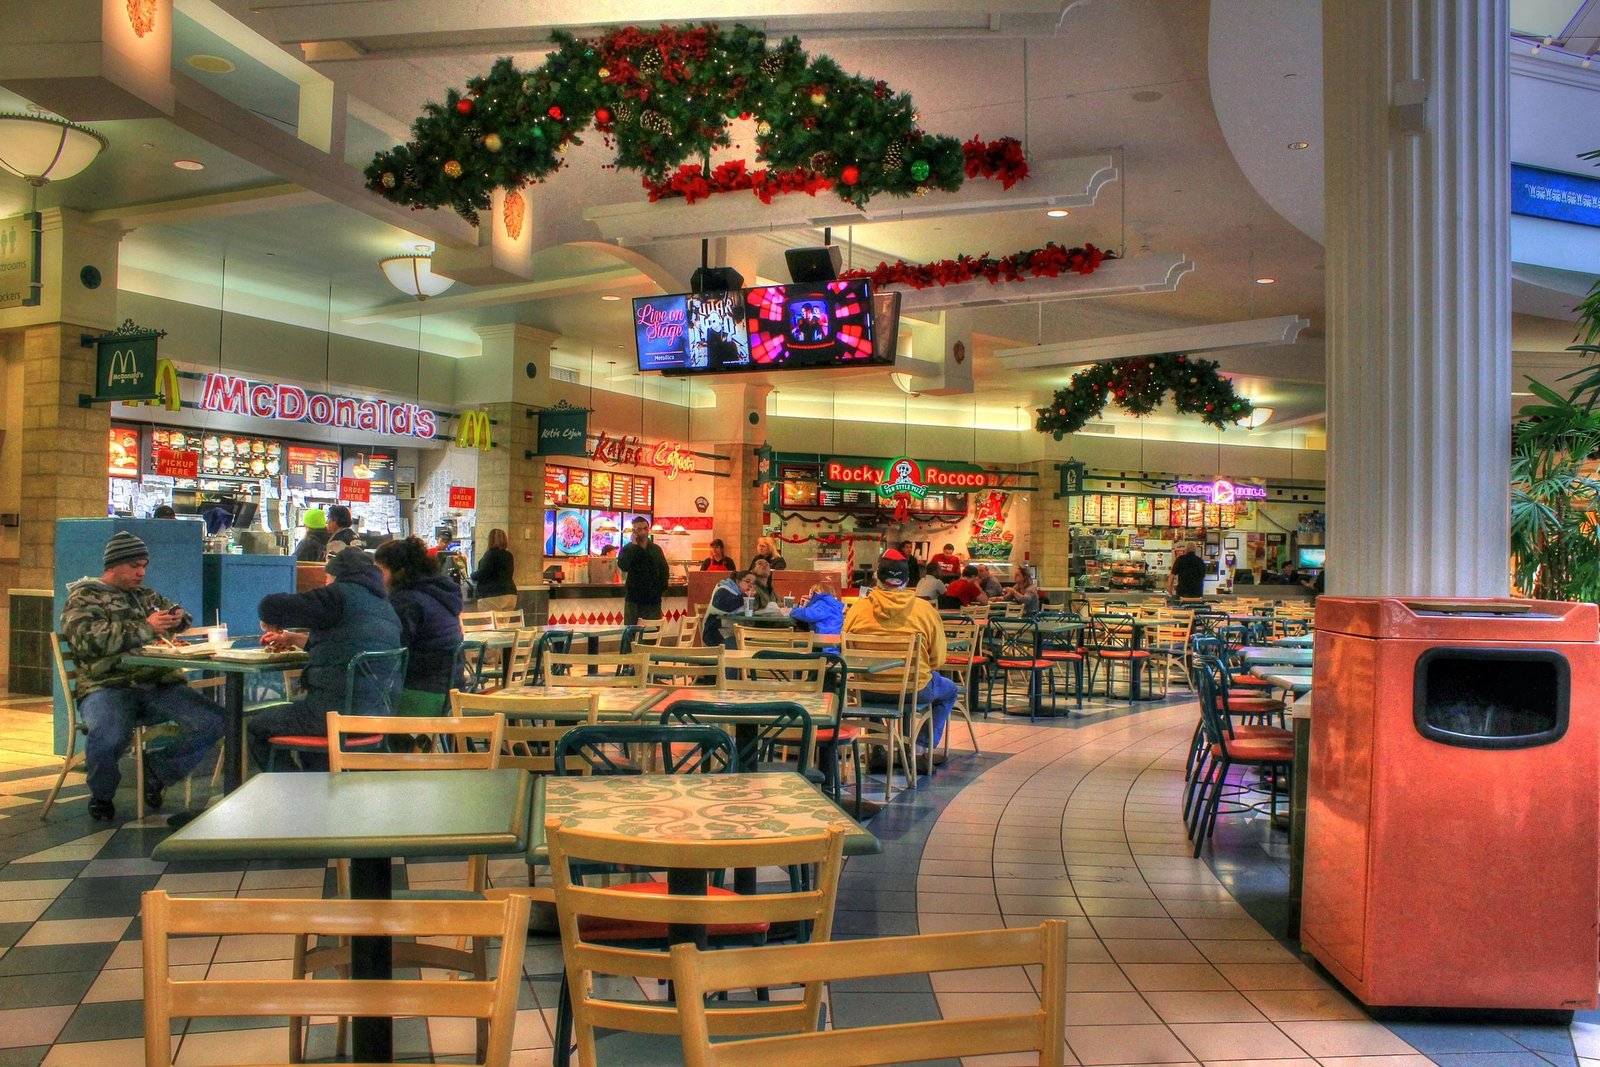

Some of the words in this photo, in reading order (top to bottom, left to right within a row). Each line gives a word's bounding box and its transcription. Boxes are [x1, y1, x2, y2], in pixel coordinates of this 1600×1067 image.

[637, 304, 669, 326] Live
[669, 309, 685, 322] on
[646, 322, 684, 346] Stage
[112, 371, 144, 380] McDonald's
[200, 373, 437, 439] McDonald's
[161, 458, 194, 469] PICKUP
[653, 441, 695, 481] Cajun
[165, 467, 189, 476] HERE
[829, 463, 885, 486] Rocky
[926, 468, 985, 486] Rococo
[343, 486, 366, 494] ORDER
[1177, 484, 1212, 494] TACO
[1235, 487, 1267, 496] BELL
[345, 493, 364, 501] HERE
